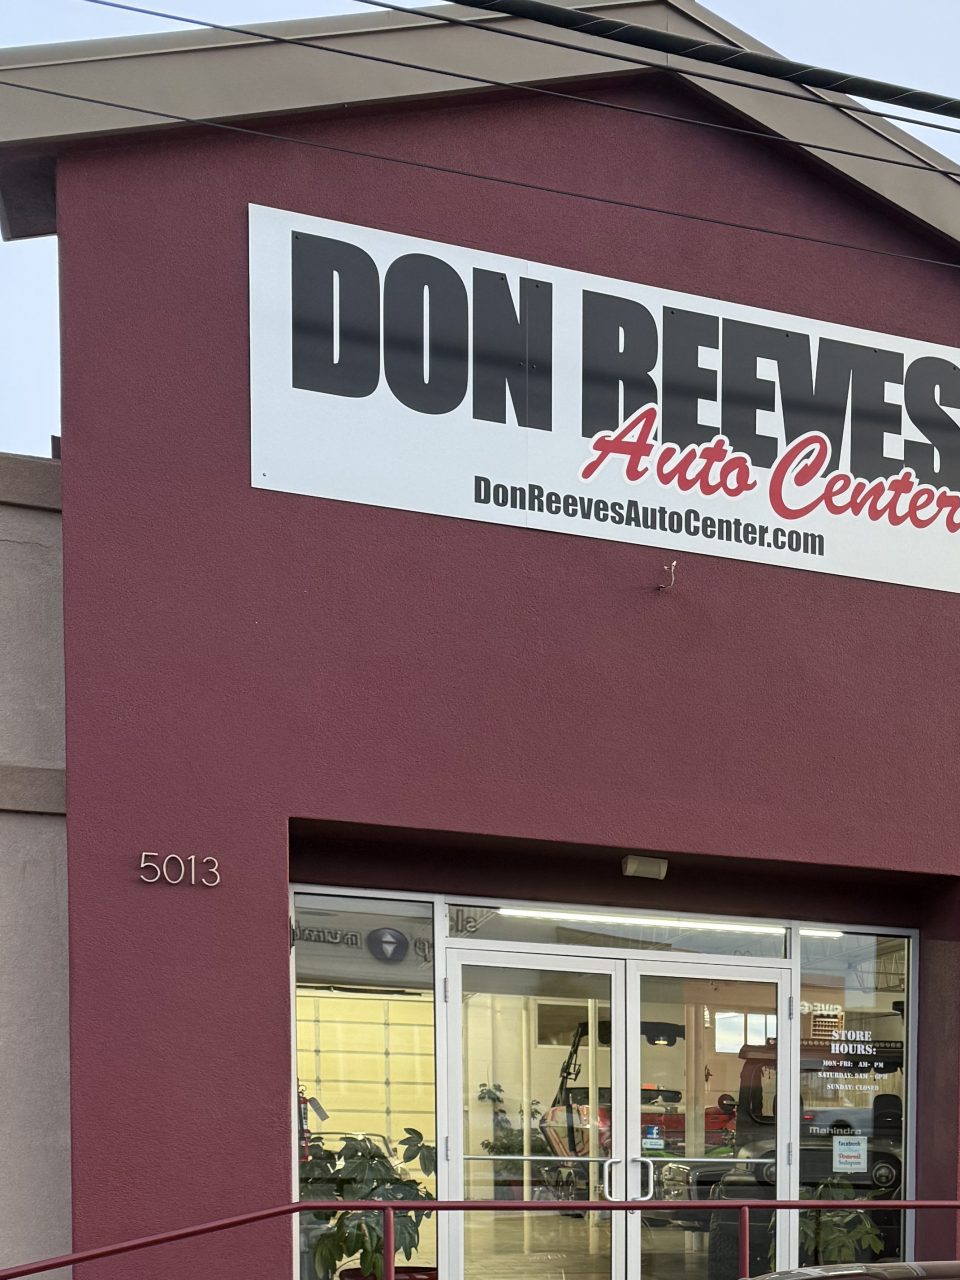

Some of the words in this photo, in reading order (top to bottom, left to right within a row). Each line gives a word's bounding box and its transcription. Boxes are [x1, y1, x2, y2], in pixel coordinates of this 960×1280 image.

[291, 230, 553, 432] DON
[581, 407, 757, 497] Auto
[474, 475, 825, 556] DonReevesAutoCenter.com
[140, 852, 220, 887] 5013
[831, 1043, 877, 1055] HOURS:
[832, 1030, 872, 1041] STORE
[809, 1127, 862, 1135] Mahindra
